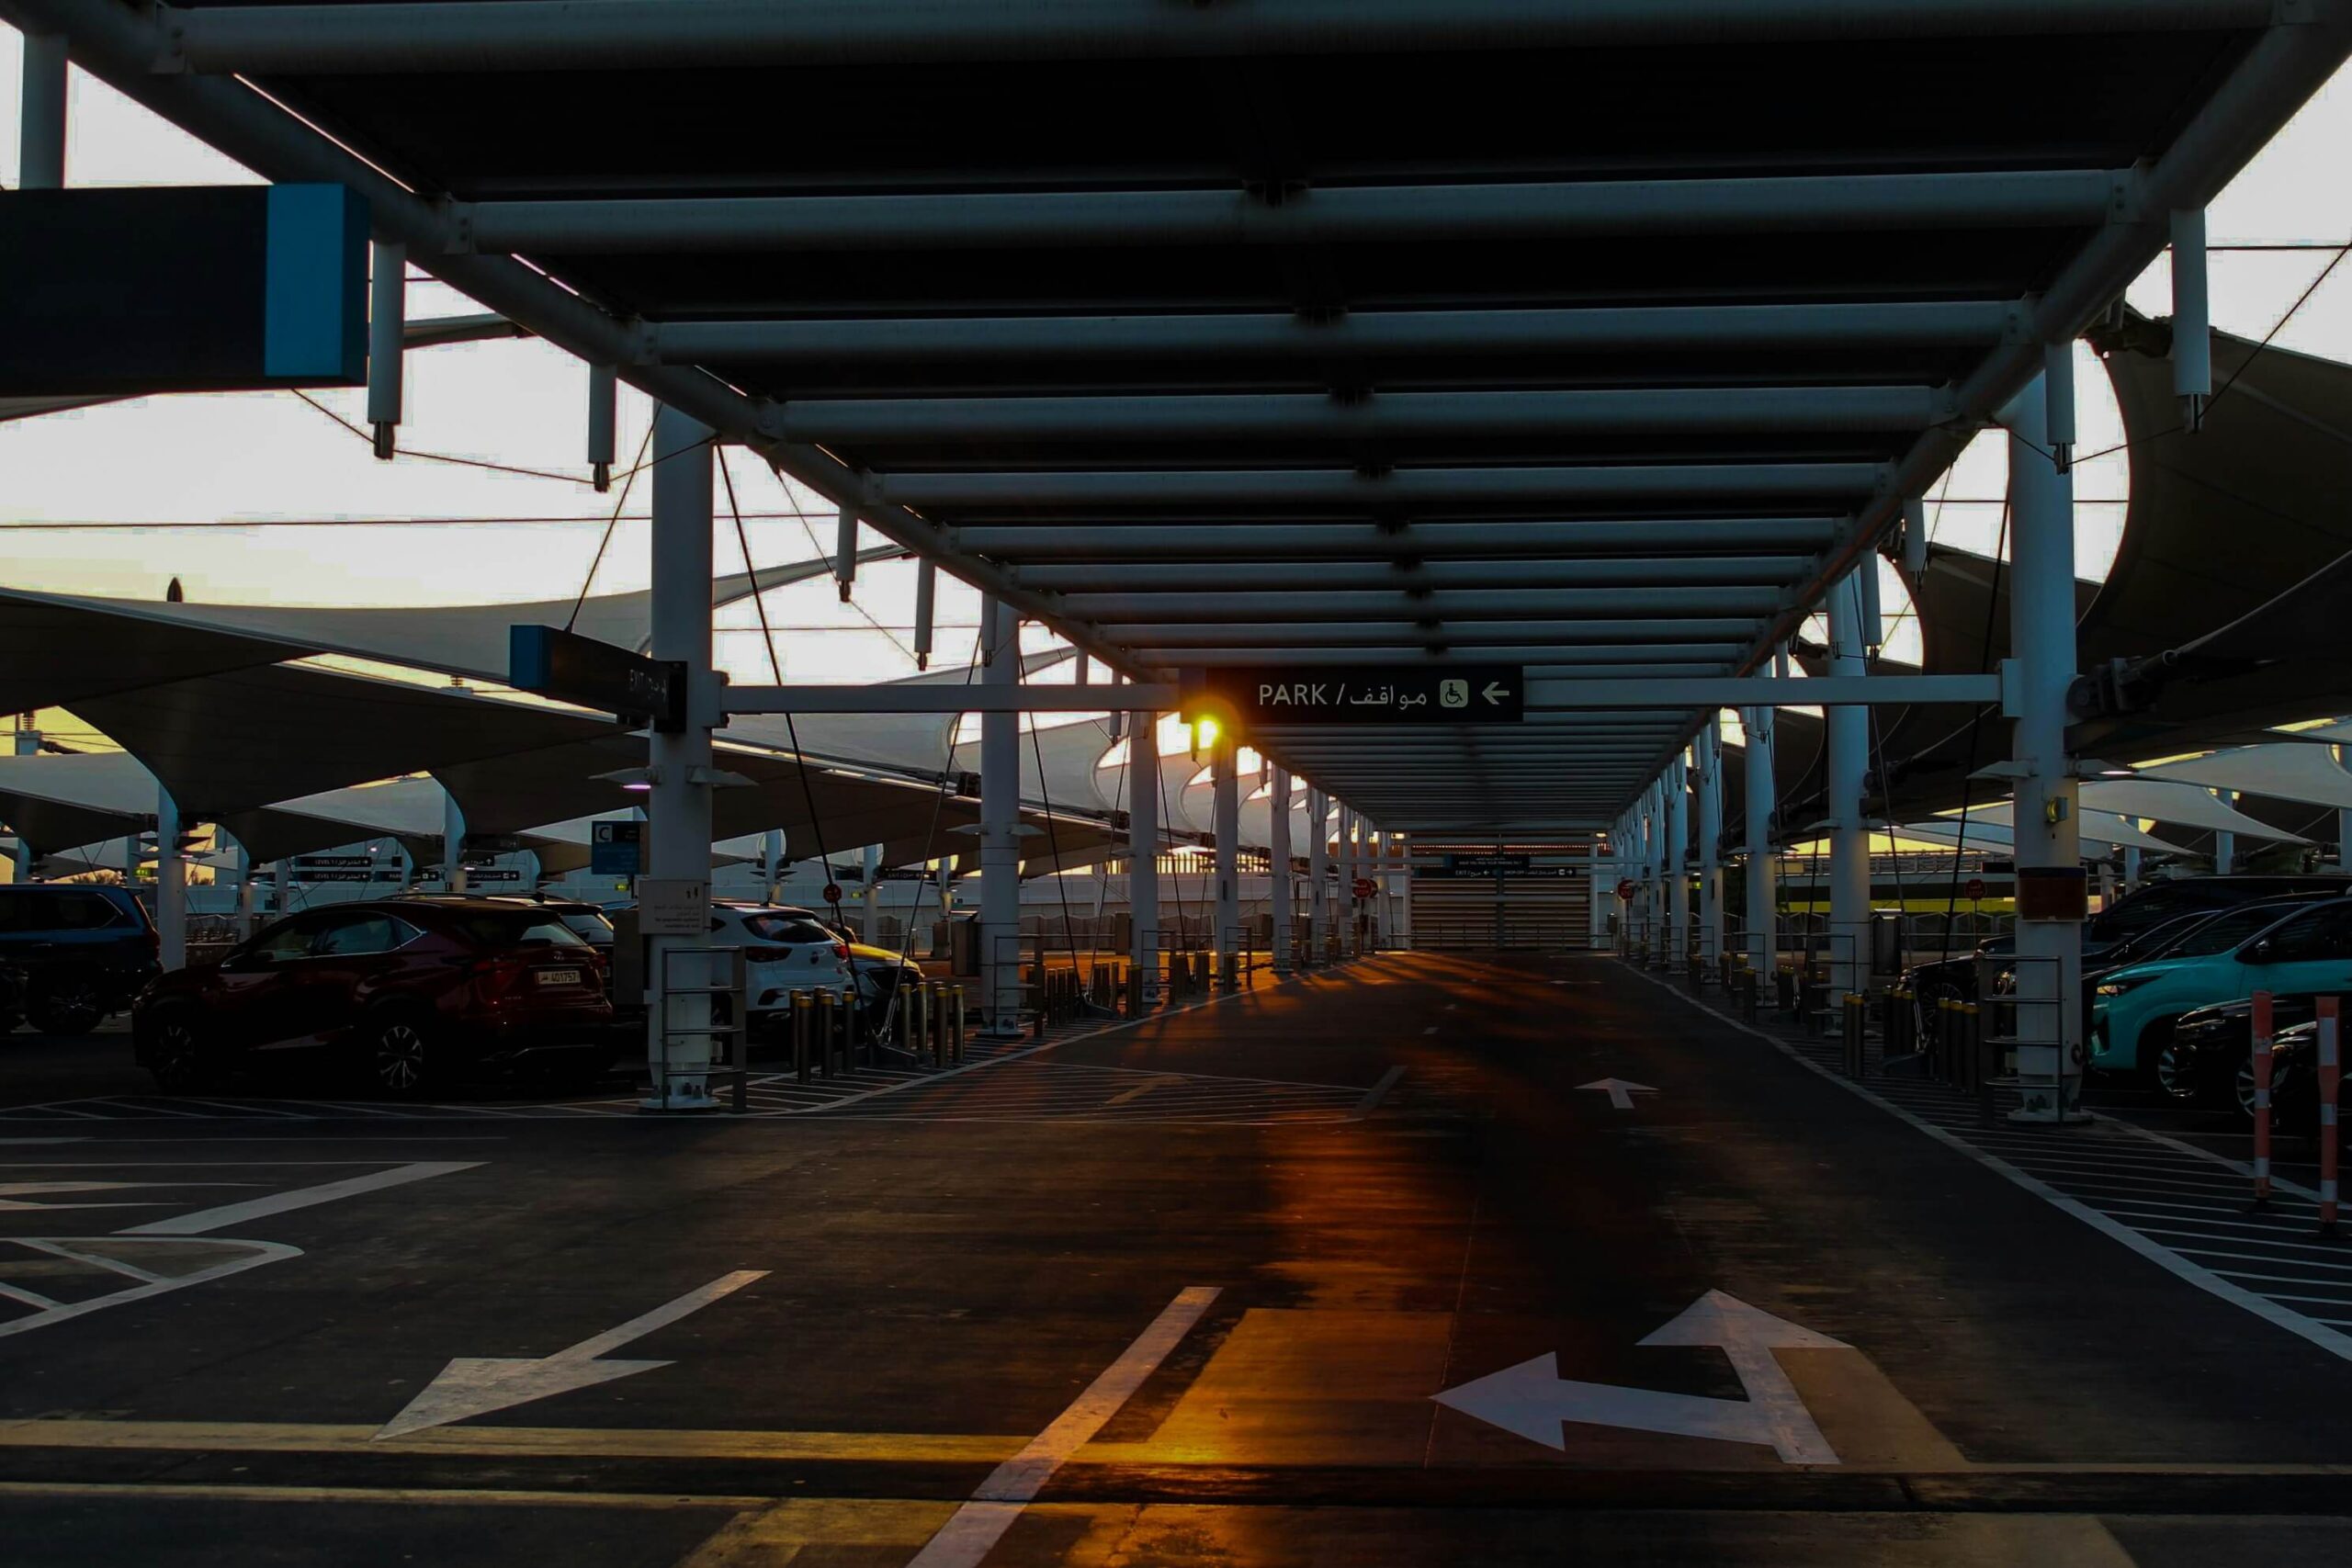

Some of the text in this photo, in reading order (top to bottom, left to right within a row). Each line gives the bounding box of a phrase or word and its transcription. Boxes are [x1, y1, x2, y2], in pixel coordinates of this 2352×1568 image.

[1259, 683, 1329, 706] PARK
[1349, 683, 1428, 711] مواقف
[599, 827, 610, 840] C
